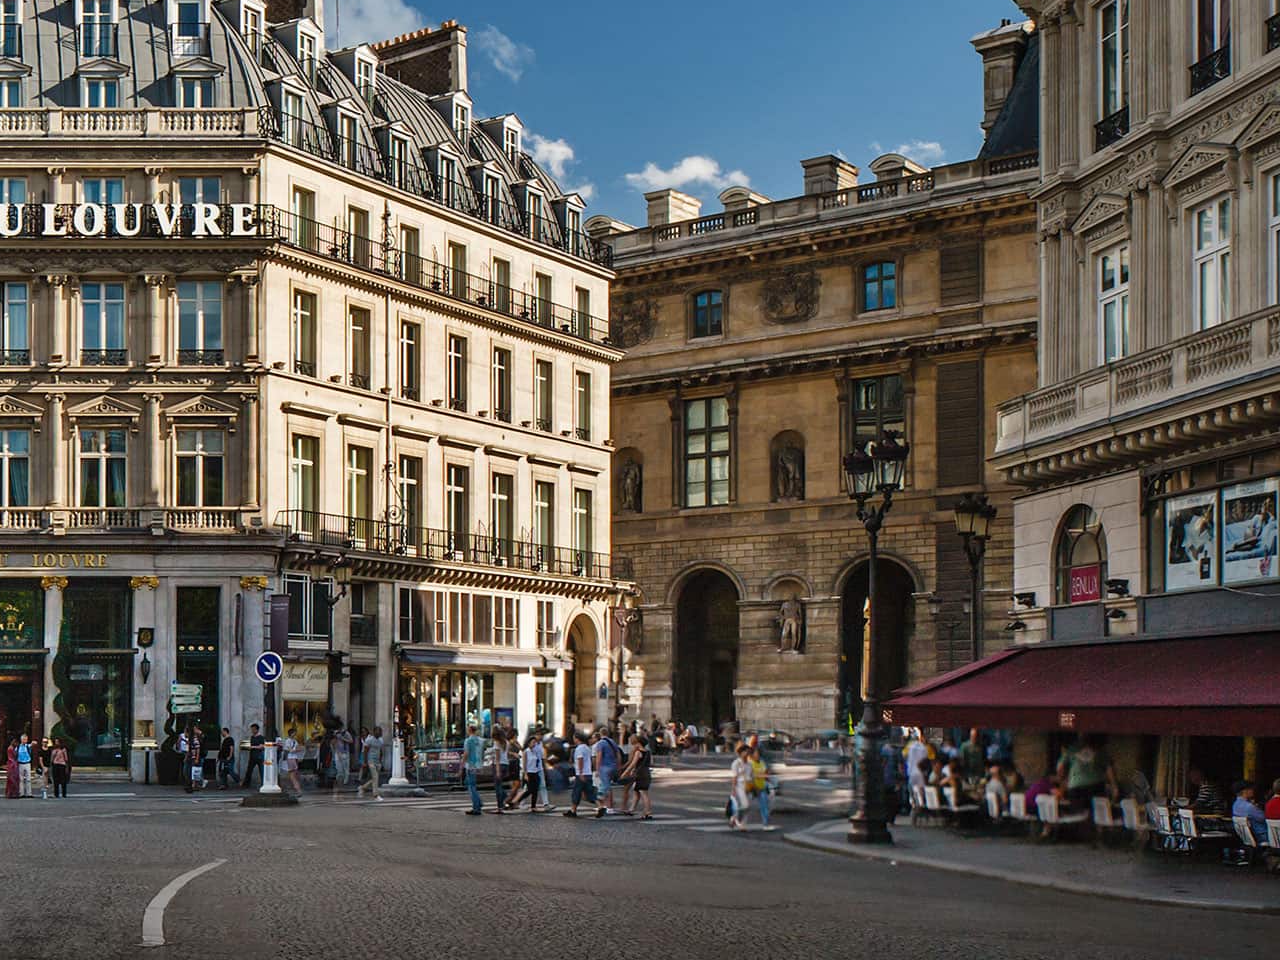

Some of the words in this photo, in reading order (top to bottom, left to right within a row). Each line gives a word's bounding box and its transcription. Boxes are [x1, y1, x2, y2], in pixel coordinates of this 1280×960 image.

[40, 202, 257, 237] LOUVRE
[32, 553, 109, 568] LOUVRE
[1071, 575, 1099, 597] BENLUX
